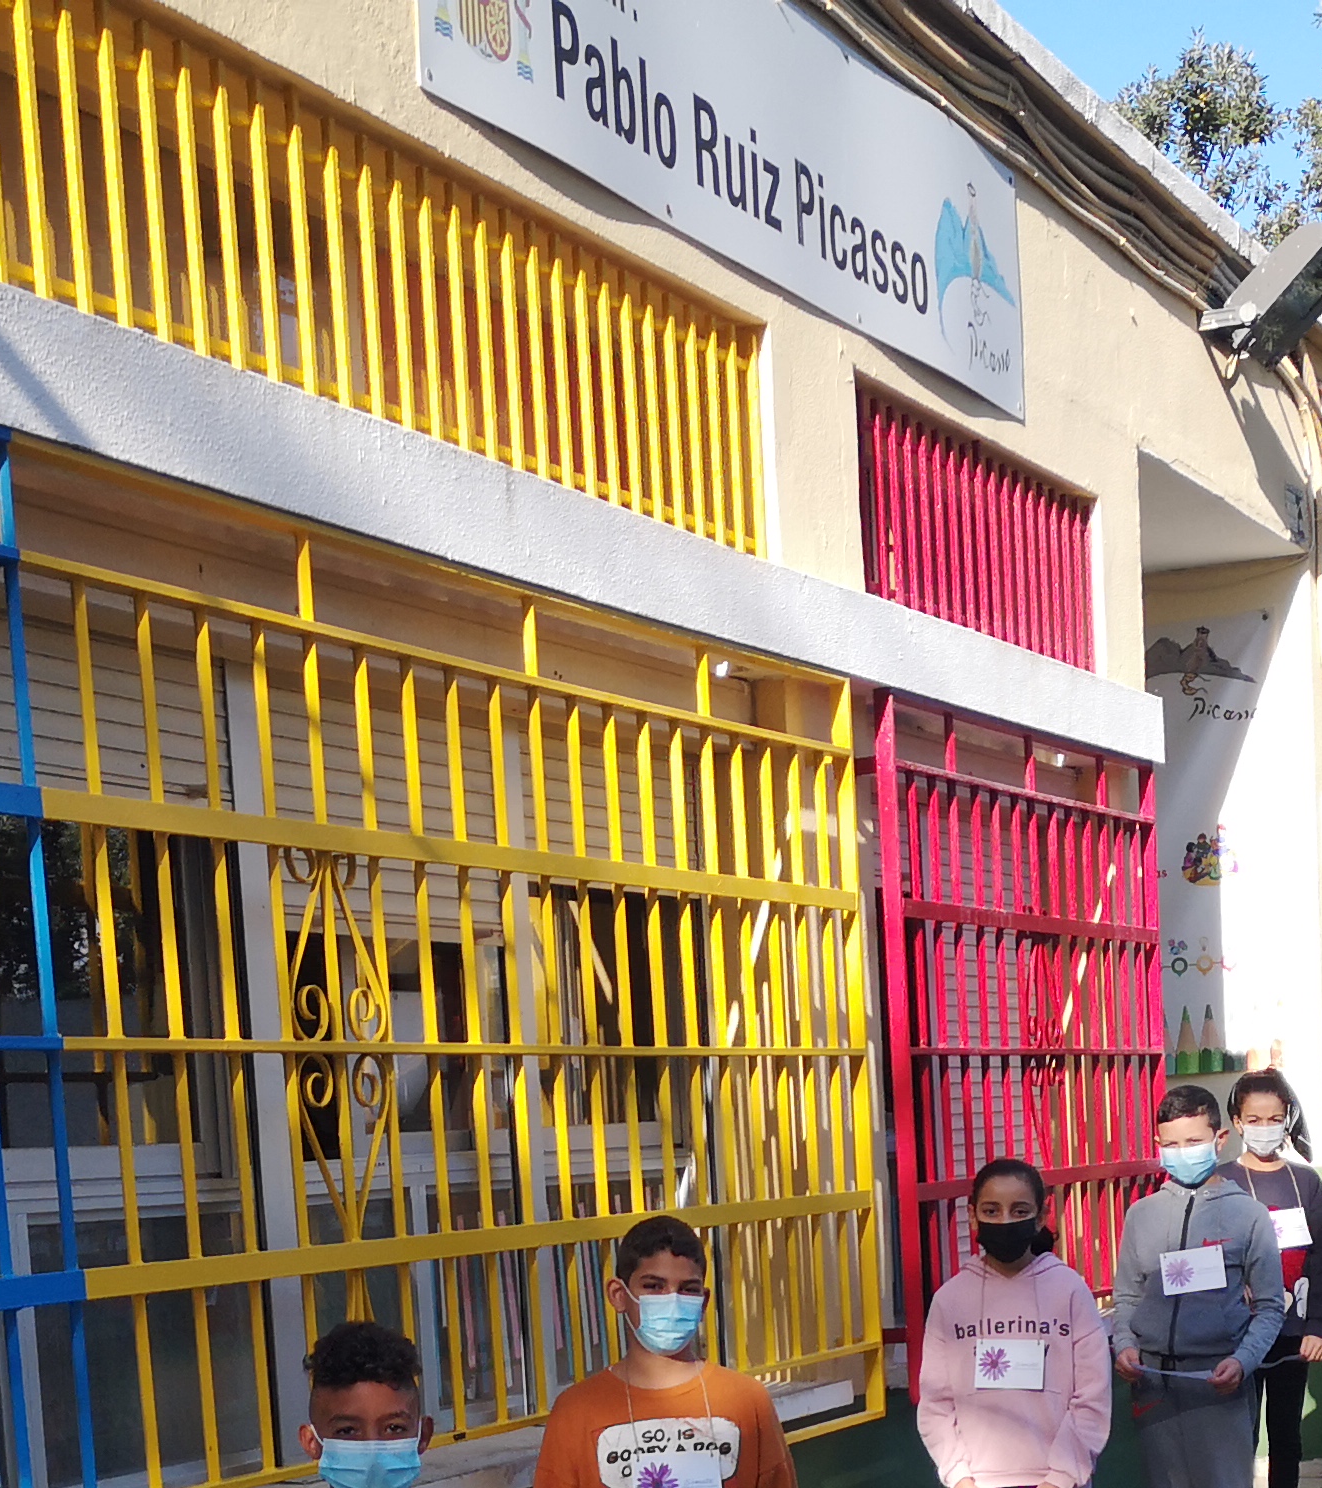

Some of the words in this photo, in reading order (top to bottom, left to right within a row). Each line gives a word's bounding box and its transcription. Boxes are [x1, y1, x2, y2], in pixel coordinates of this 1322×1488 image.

[551, 0, 677, 170] Pablo
[692, 92, 783, 233] Ruiz
[794, 157, 929, 315] Picasso
[954, 1315, 1071, 1340] ballerina's
[641, 1428, 671, 1443] SO,
[677, 1428, 695, 1440] IS
[693, 1441, 732, 1455] DOG
